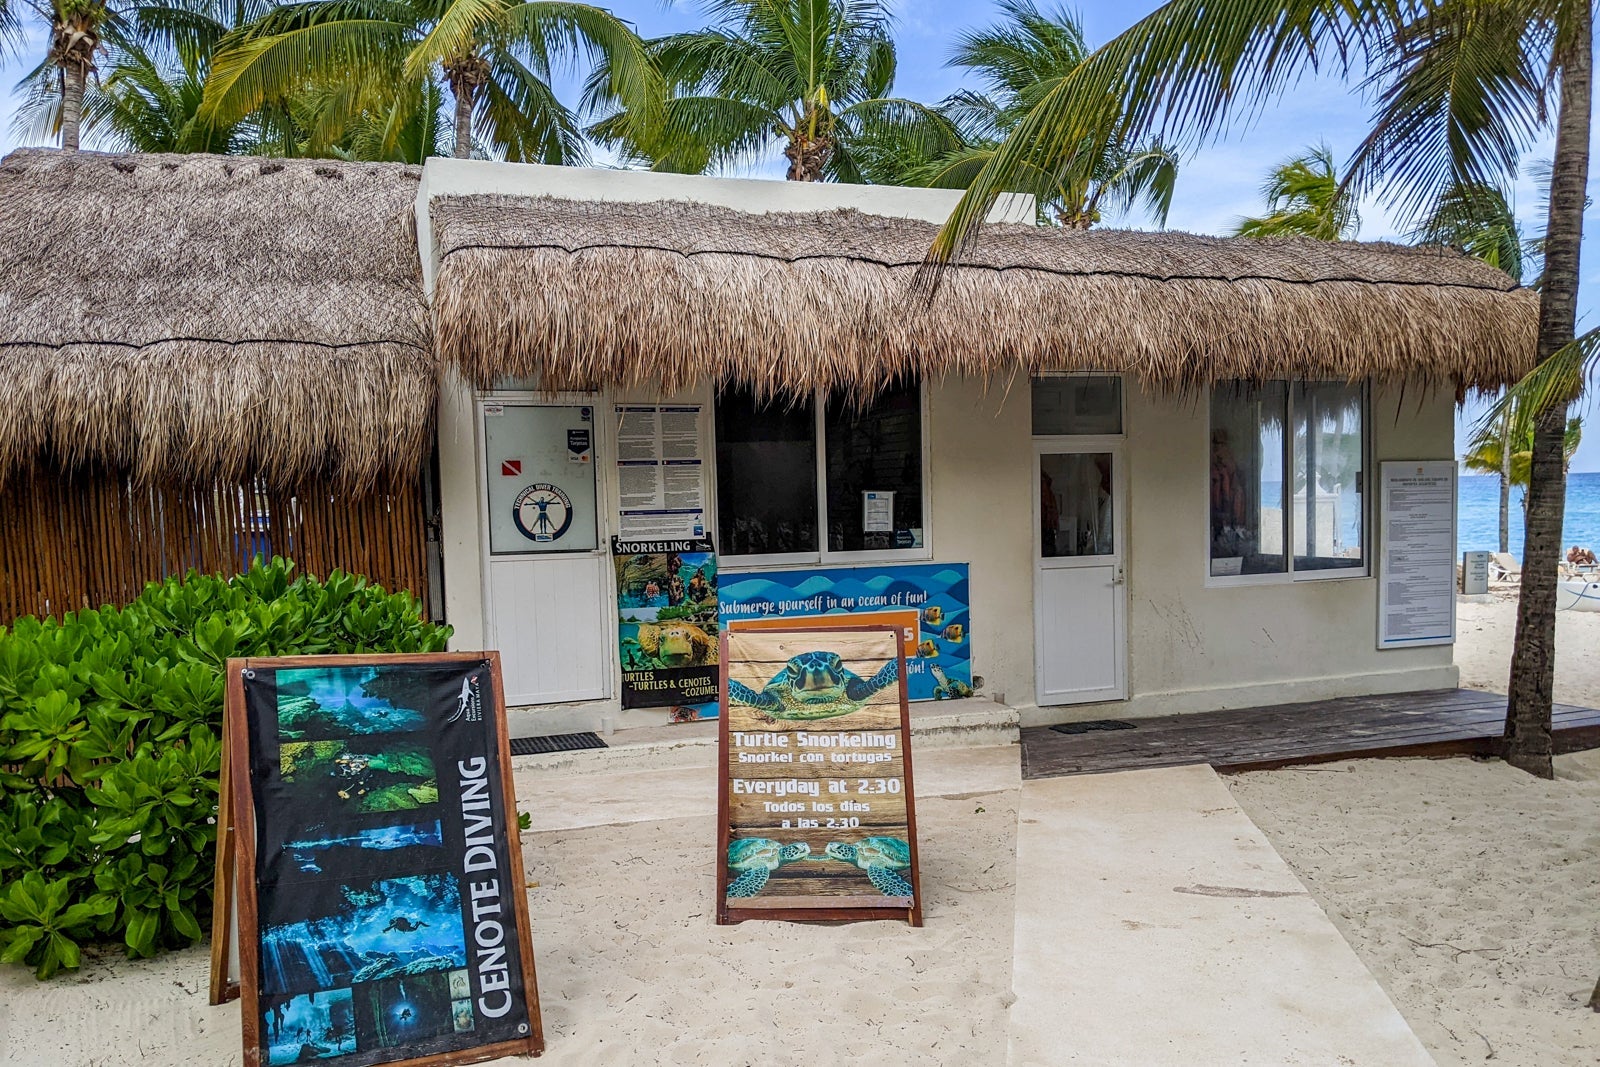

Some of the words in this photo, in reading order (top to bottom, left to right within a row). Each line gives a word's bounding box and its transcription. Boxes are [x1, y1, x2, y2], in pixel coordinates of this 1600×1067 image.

[514, 486, 535, 510] TECHNICAL
[552, 486, 571, 508] TRAINING
[616, 541, 691, 554] SNORKELING
[720, 600, 775, 616] Submerge
[778, 596, 822, 614] yourself
[826, 596, 838, 608] in
[841, 596, 854, 608] an
[858, 595, 888, 606] ocean
[891, 591, 902, 606] of
[906, 590, 928, 606] fun!
[629, 680, 668, 691] -TURTLES
[670, 680, 676, 689] &
[678, 676, 712, 688] CENOTES
[732, 732, 789, 748] Turtle
[796, 732, 897, 749] Snorkeling
[738, 752, 793, 763] Snorkel
[800, 753, 824, 762] con
[831, 752, 892, 764] tortugas
[733, 778, 820, 797] Everyday
[828, 779, 848, 794] at
[457, 756, 498, 874] DIVING
[763, 802, 806, 812] Todos
[812, 802, 834, 812] los
[782, 819, 790, 828] a
[798, 818, 819, 828] las
[470, 879, 513, 1018] CENOTE
